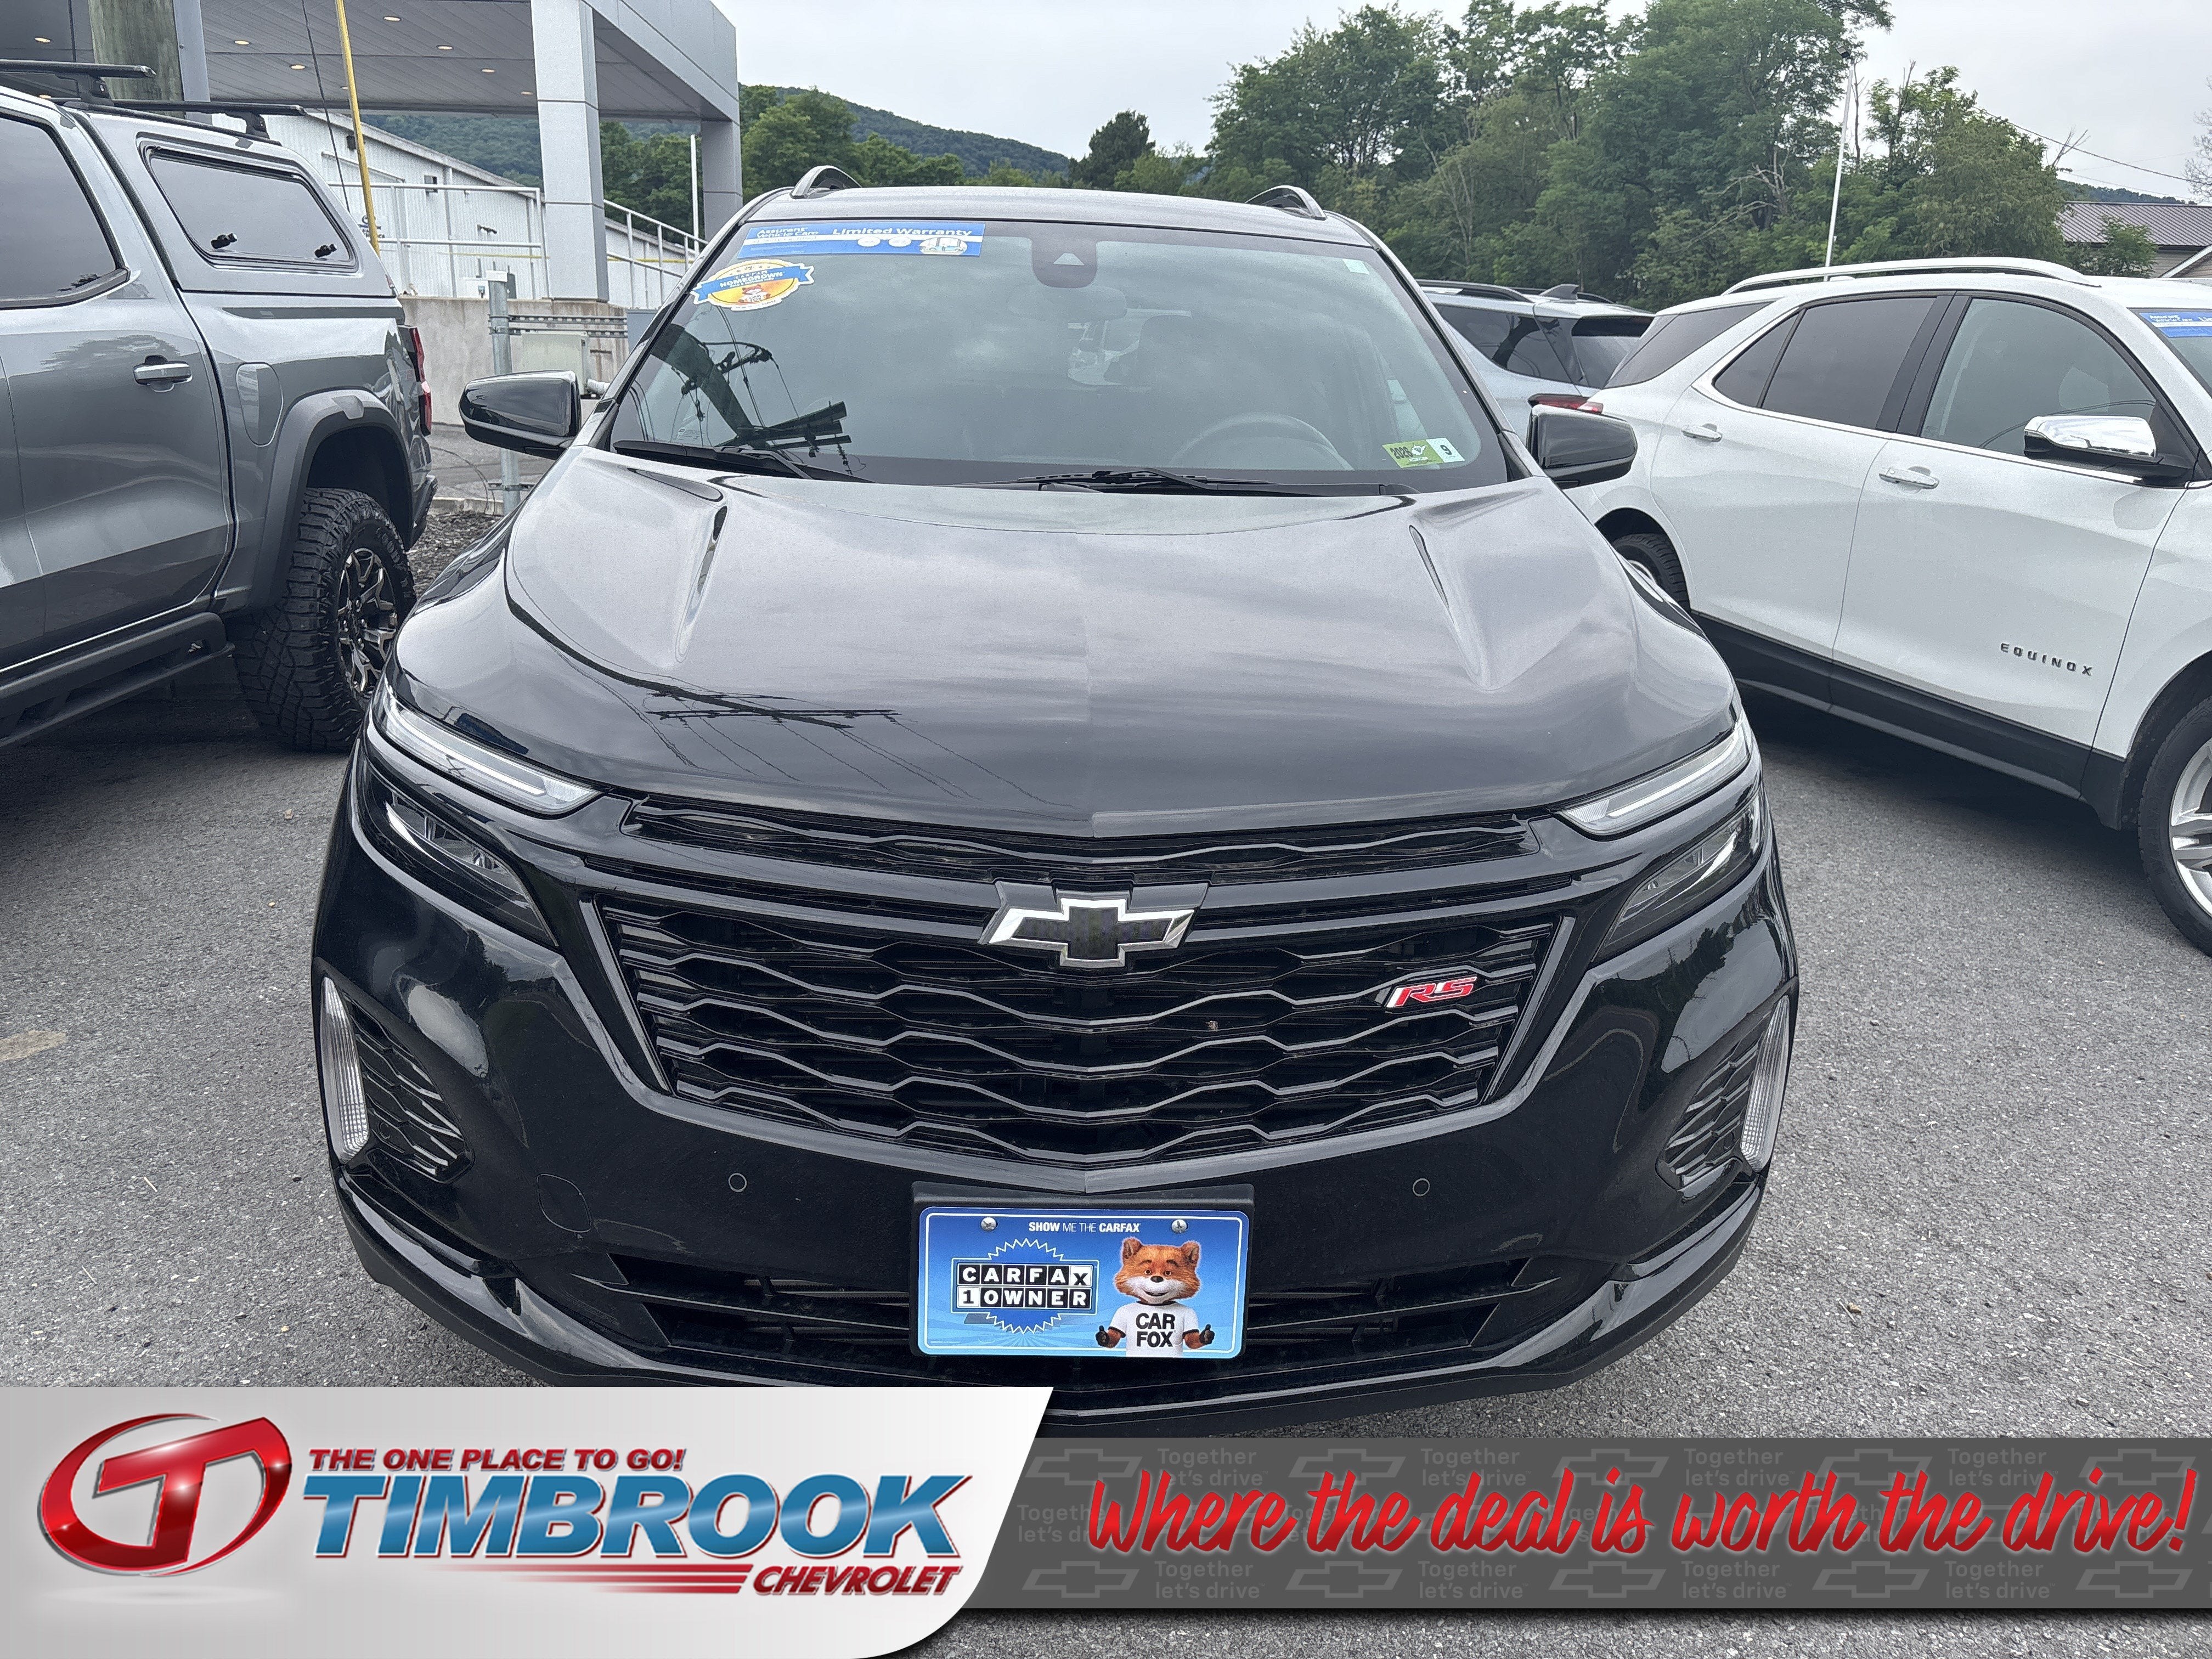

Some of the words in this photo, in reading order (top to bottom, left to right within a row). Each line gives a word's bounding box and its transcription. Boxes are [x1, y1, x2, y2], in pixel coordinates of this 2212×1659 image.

[896, 228, 973, 236] Warranty
[719, 271, 783, 288] HOMEGROWN
[1390, 446, 1414, 459] 2026
[1440, 444, 1453, 455] 9
[2000, 642, 2093, 676] EQUINOX
[1386, 977, 1478, 1008] RS
[1029, 1222, 1060, 1232] SHOW
[1063, 1222, 1077, 1232] ME
[1079, 1222, 1097, 1232] THE
[1099, 1223, 1140, 1233] CARFAX
[962, 1266, 1087, 1286] CARFAX
[1136, 1313, 1175, 1330] CAR
[1136, 1331, 1176, 1347] FOX
